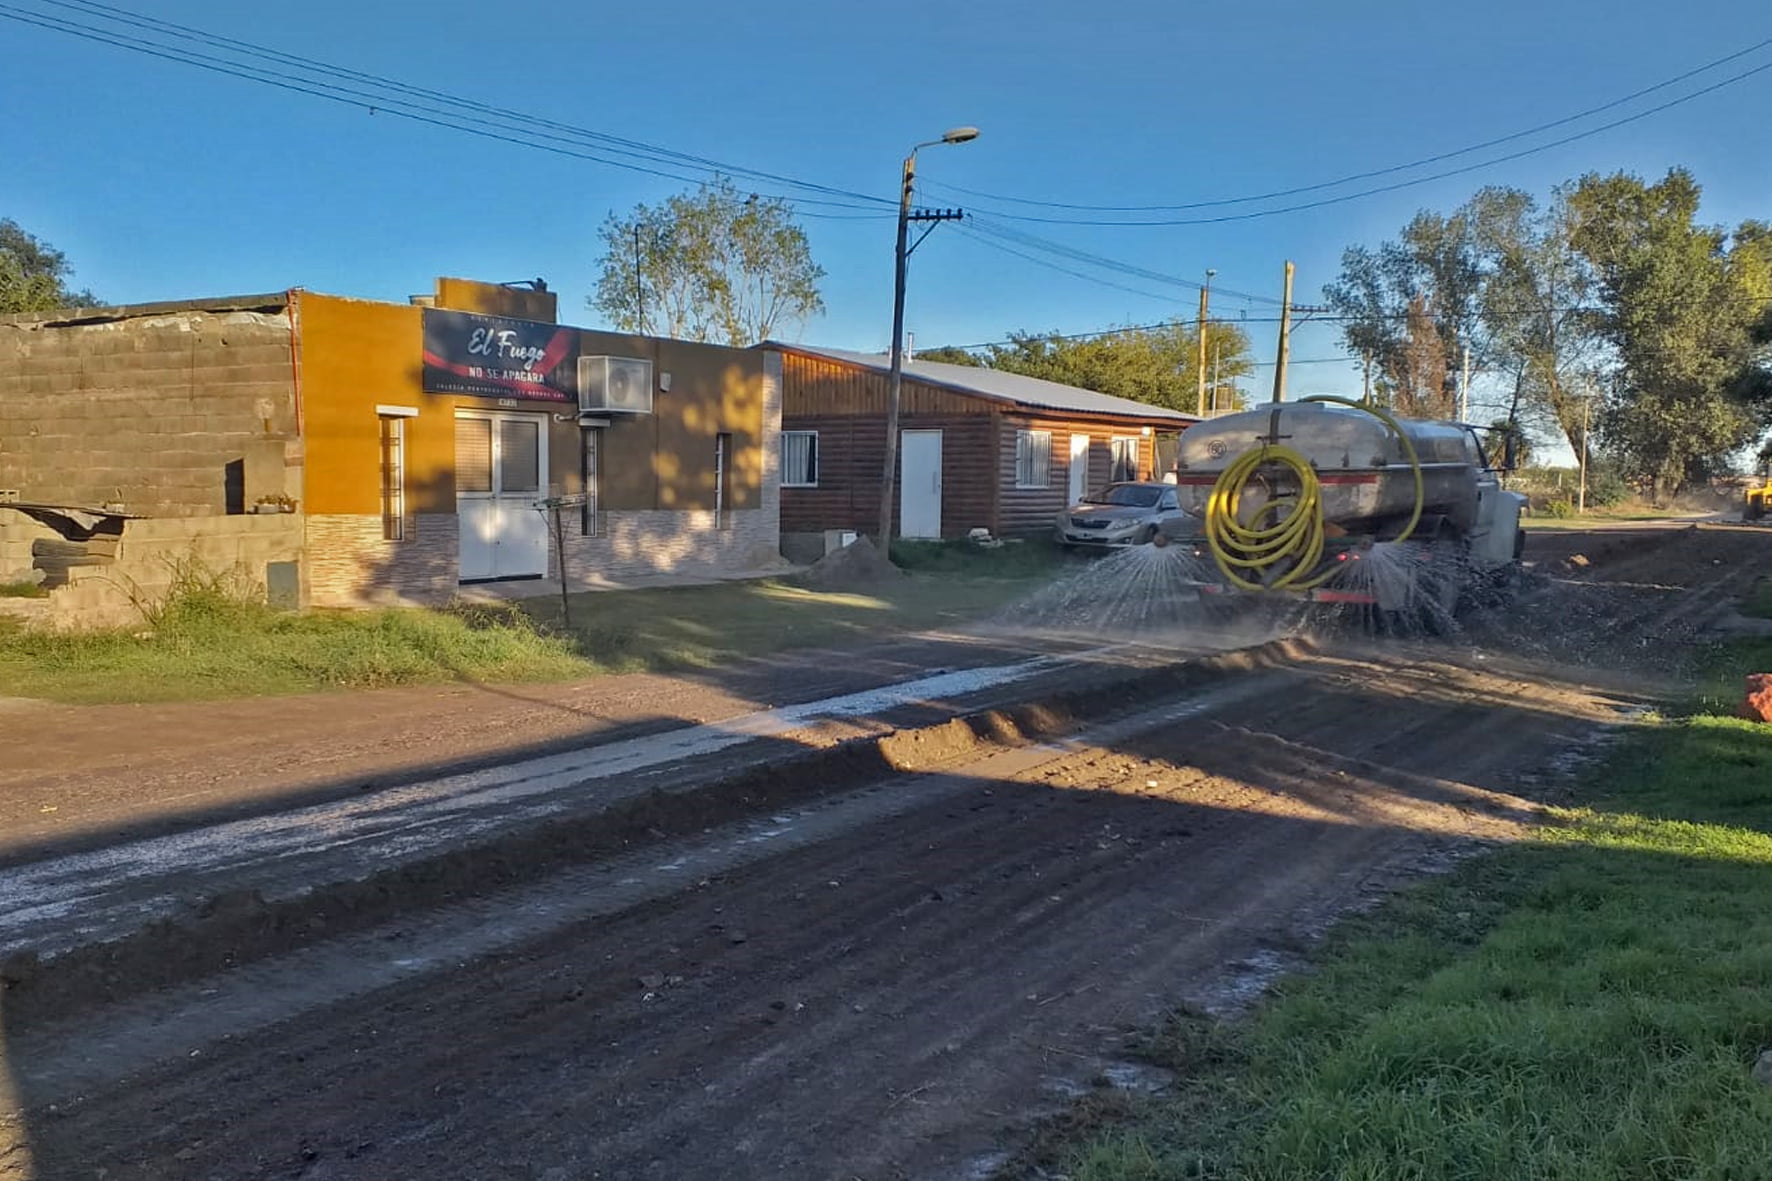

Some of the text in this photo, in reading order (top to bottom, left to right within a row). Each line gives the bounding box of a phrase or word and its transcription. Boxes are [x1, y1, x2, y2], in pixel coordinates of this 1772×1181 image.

[468, 328, 546, 371] El Fuego
[469, 367, 483, 378] NO
[486, 368, 499, 379] SE
